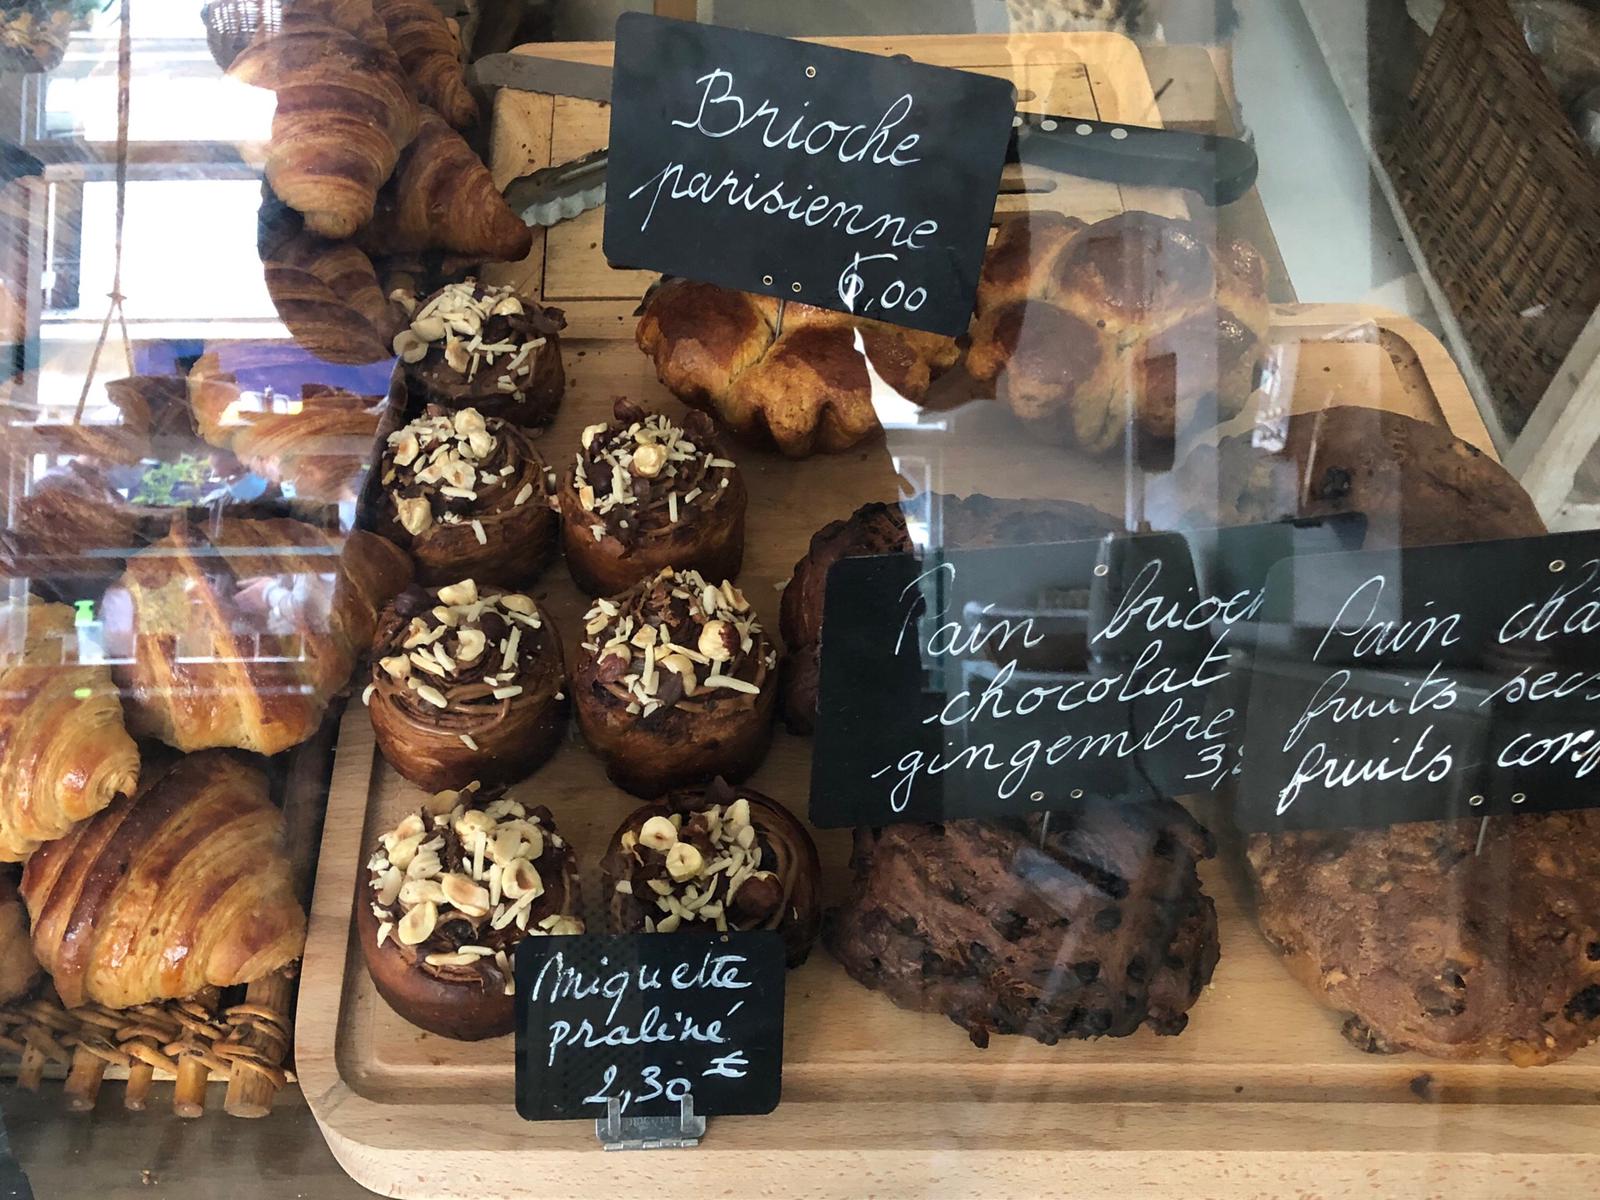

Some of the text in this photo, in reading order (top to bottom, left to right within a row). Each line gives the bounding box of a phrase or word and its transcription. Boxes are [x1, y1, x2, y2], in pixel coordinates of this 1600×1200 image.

[672, 68, 921, 166] Brioche
[628, 160, 938, 250] parisienne
[894, 562, 1045, 657] Pain
[1312, 575, 1460, 661] Pain
[1281, 660, 1457, 752] fruits
[1276, 725, 1452, 815] fruits
[548, 1000, 744, 1066] praliné
[582, 1050, 749, 1113] 2,30 €
